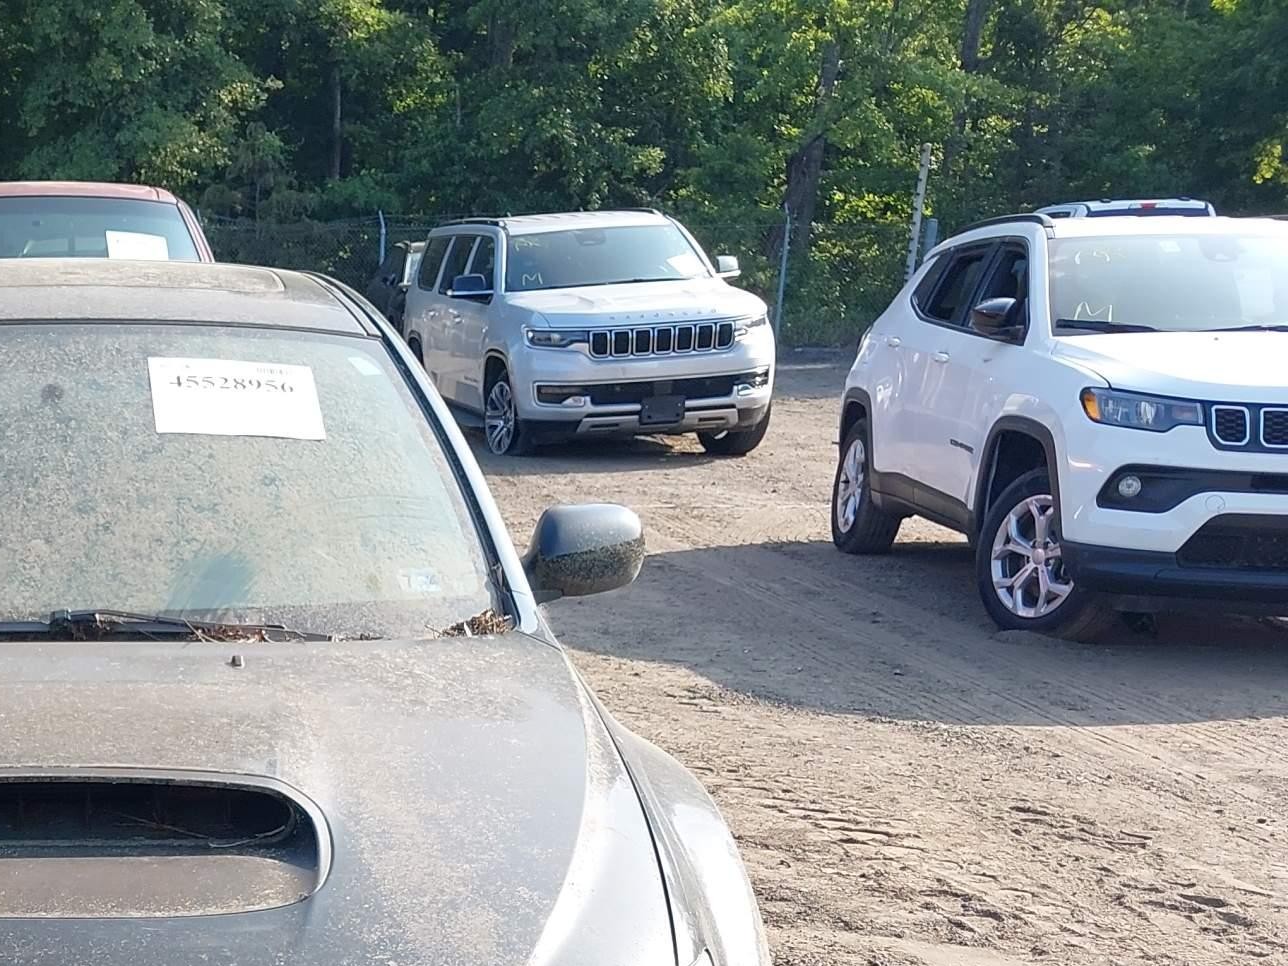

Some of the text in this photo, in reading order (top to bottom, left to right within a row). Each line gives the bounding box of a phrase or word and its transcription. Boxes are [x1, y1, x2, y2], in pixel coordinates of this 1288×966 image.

[522, 271, 544, 287] M
[1073, 300, 1113, 323] M
[169, 375, 295, 393] 45528956
